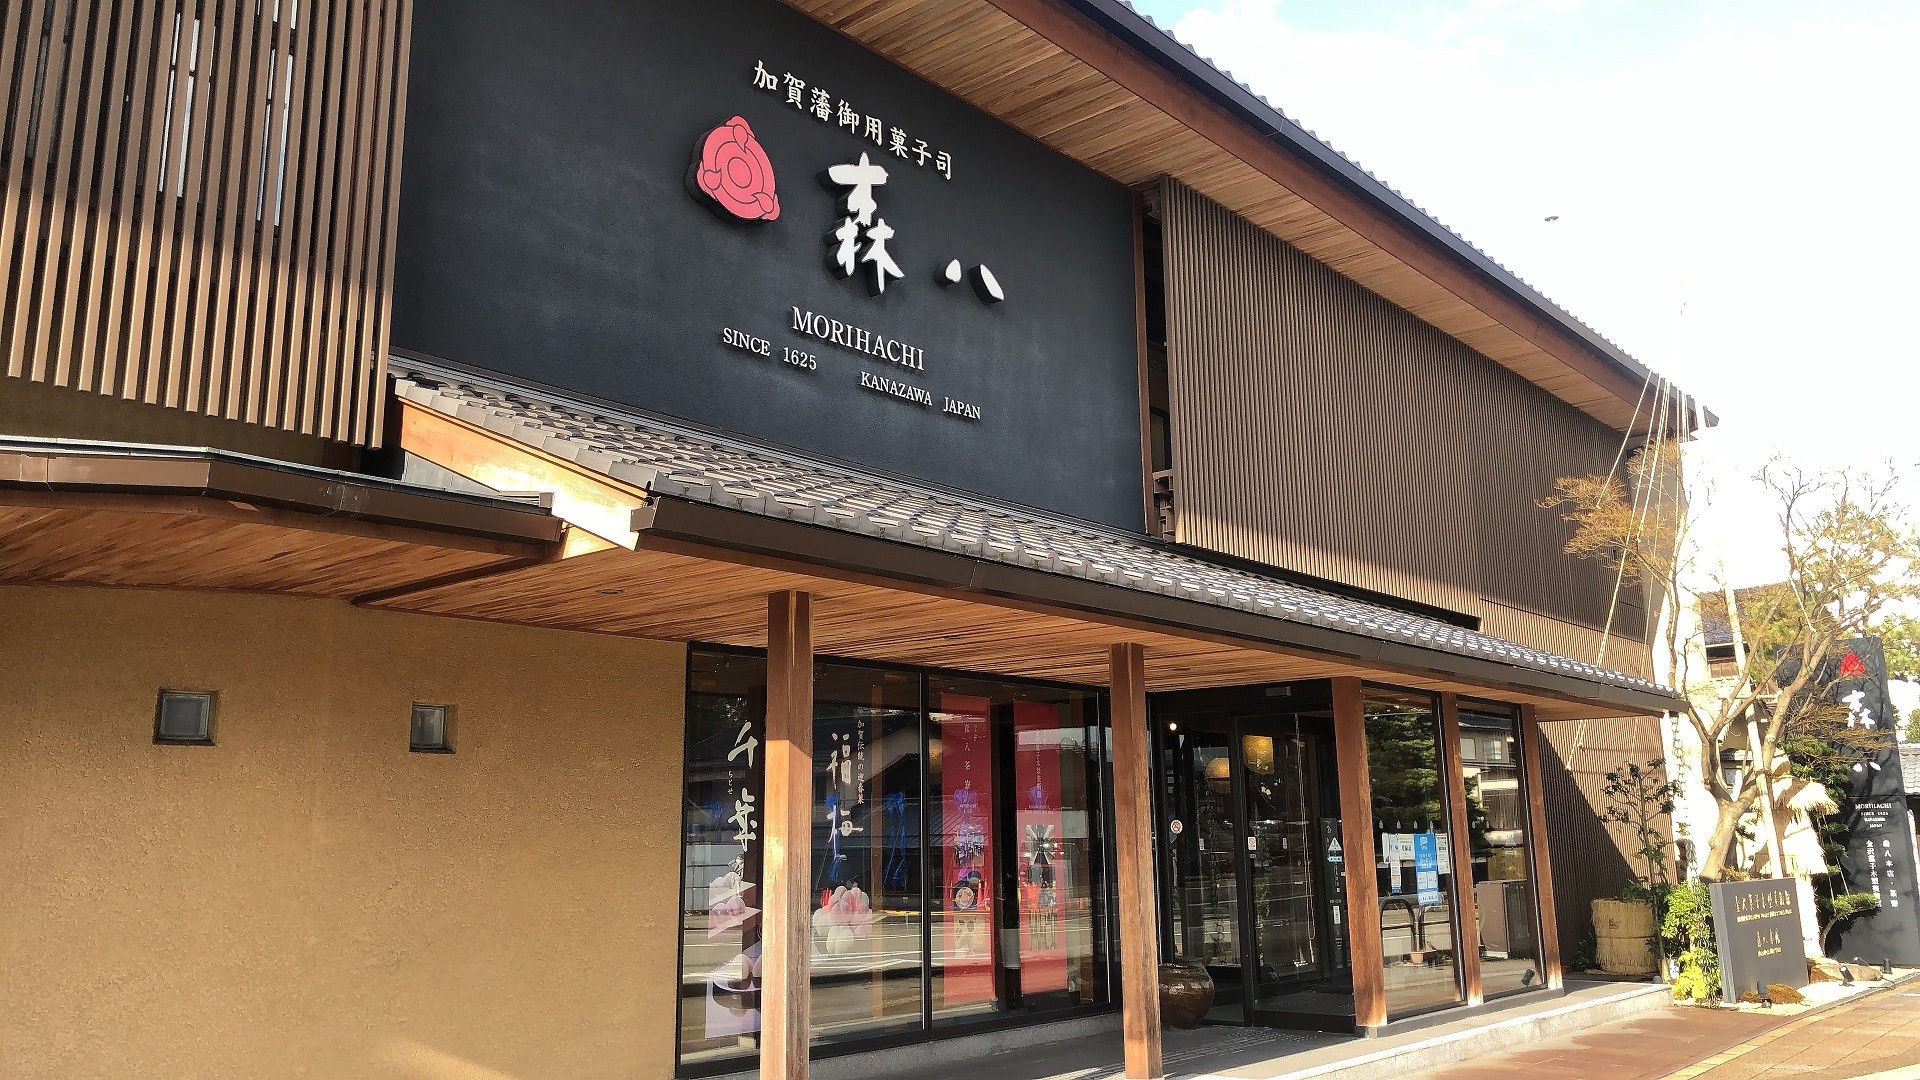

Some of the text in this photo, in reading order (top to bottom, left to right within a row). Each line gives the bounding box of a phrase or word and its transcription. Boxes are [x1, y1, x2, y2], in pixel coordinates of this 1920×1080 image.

[753, 60, 952, 180] 加賀藩御用菓子司
[828, 152, 1004, 300] 森八
[723, 328, 817, 370] SINCE 1625
[791, 306, 924, 370] MORIHACHI
[860, 371, 981, 419] KANAZAWA JAPAN
